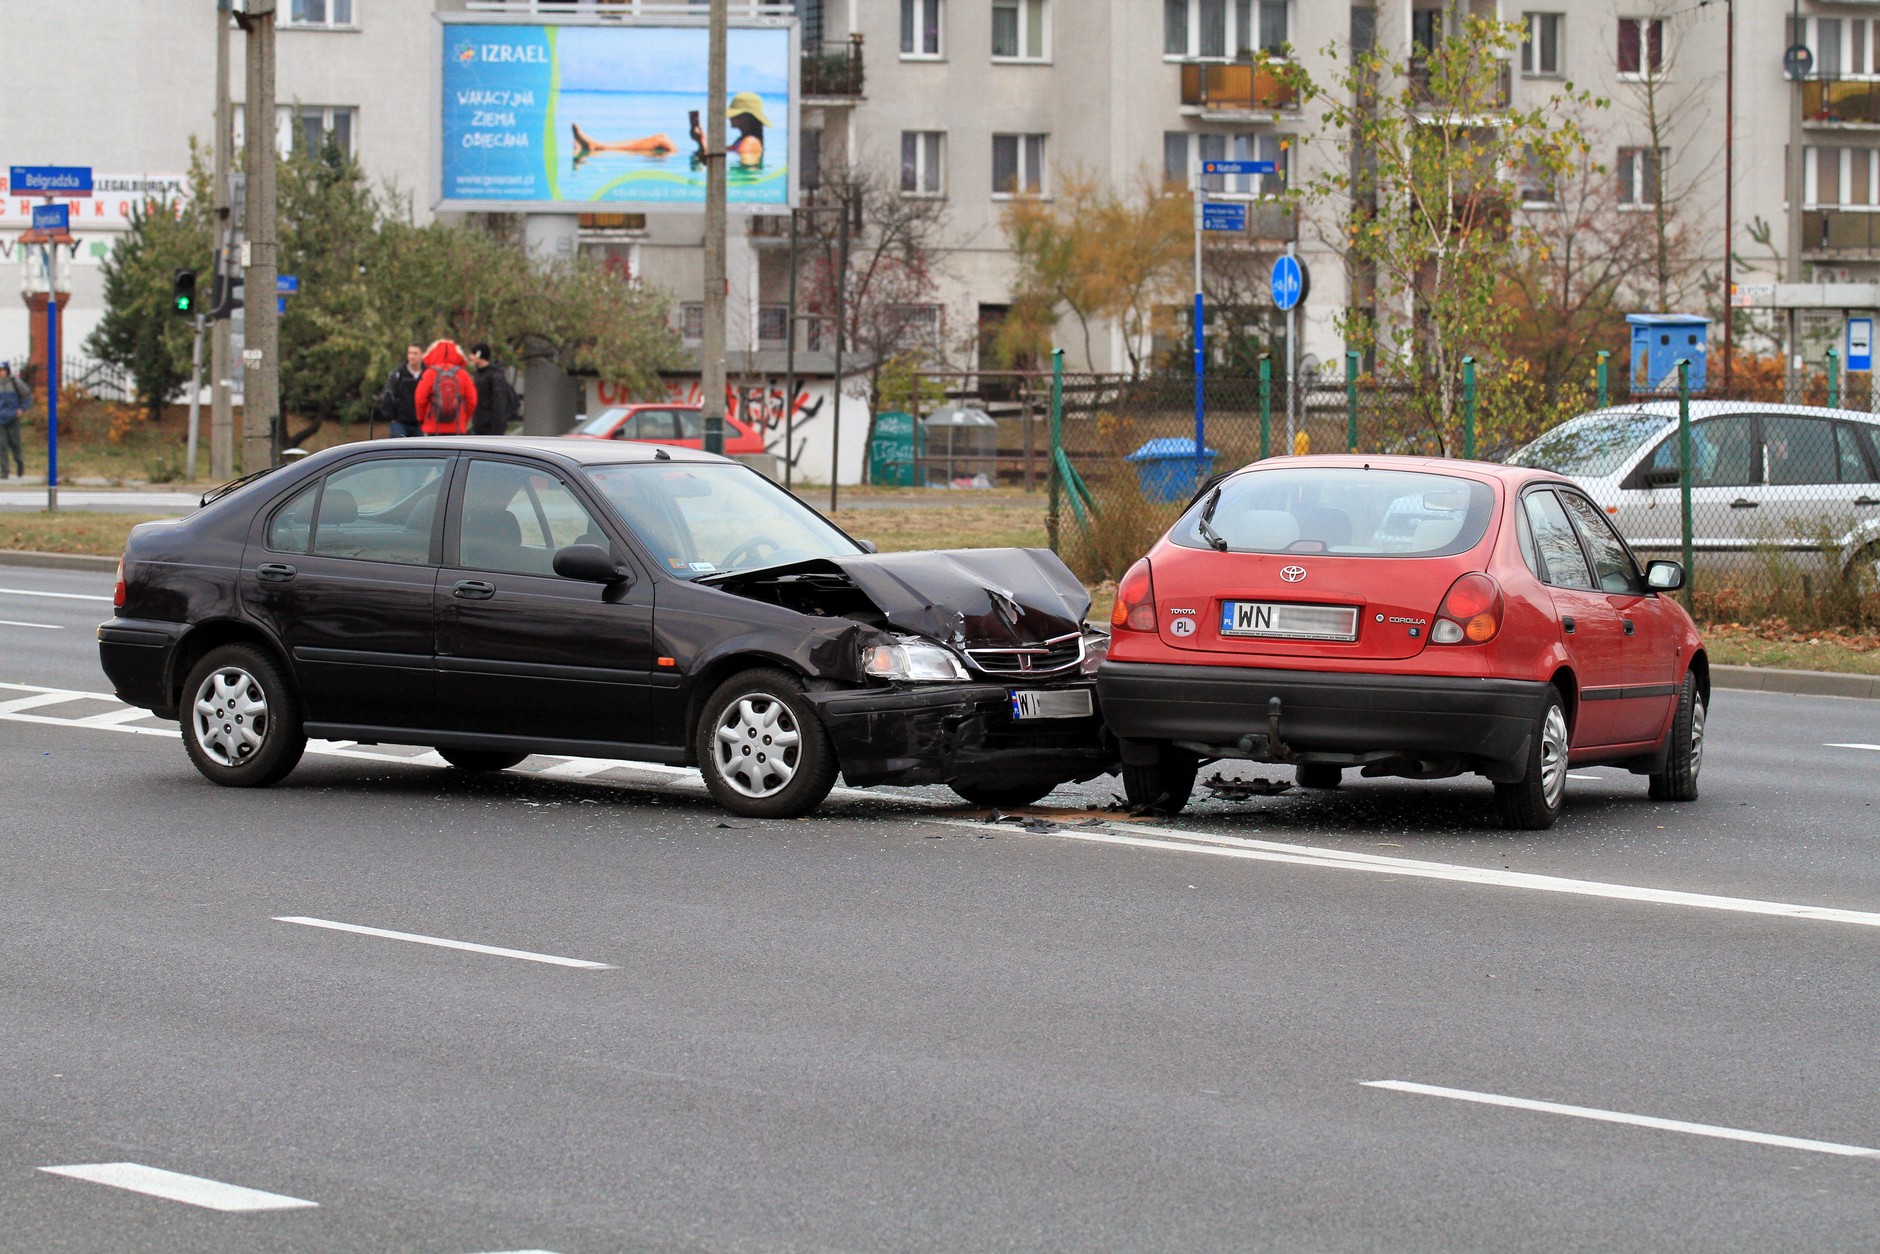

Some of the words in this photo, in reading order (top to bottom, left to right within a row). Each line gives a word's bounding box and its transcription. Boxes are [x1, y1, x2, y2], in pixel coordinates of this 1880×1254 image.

[481, 44, 548, 63] IZRAEL
[456, 88, 534, 107] WAKACYJNA
[471, 110, 516, 127] ZIEMIA
[462, 131, 529, 149] OBIECANA
[1217, 164, 1241, 172] Natolin
[25, 173, 80, 190] Belgradzka
[1238, 605, 1272, 629] WN
[1389, 616, 1426, 625] COROLLA
[1176, 621, 1190, 632] PL
